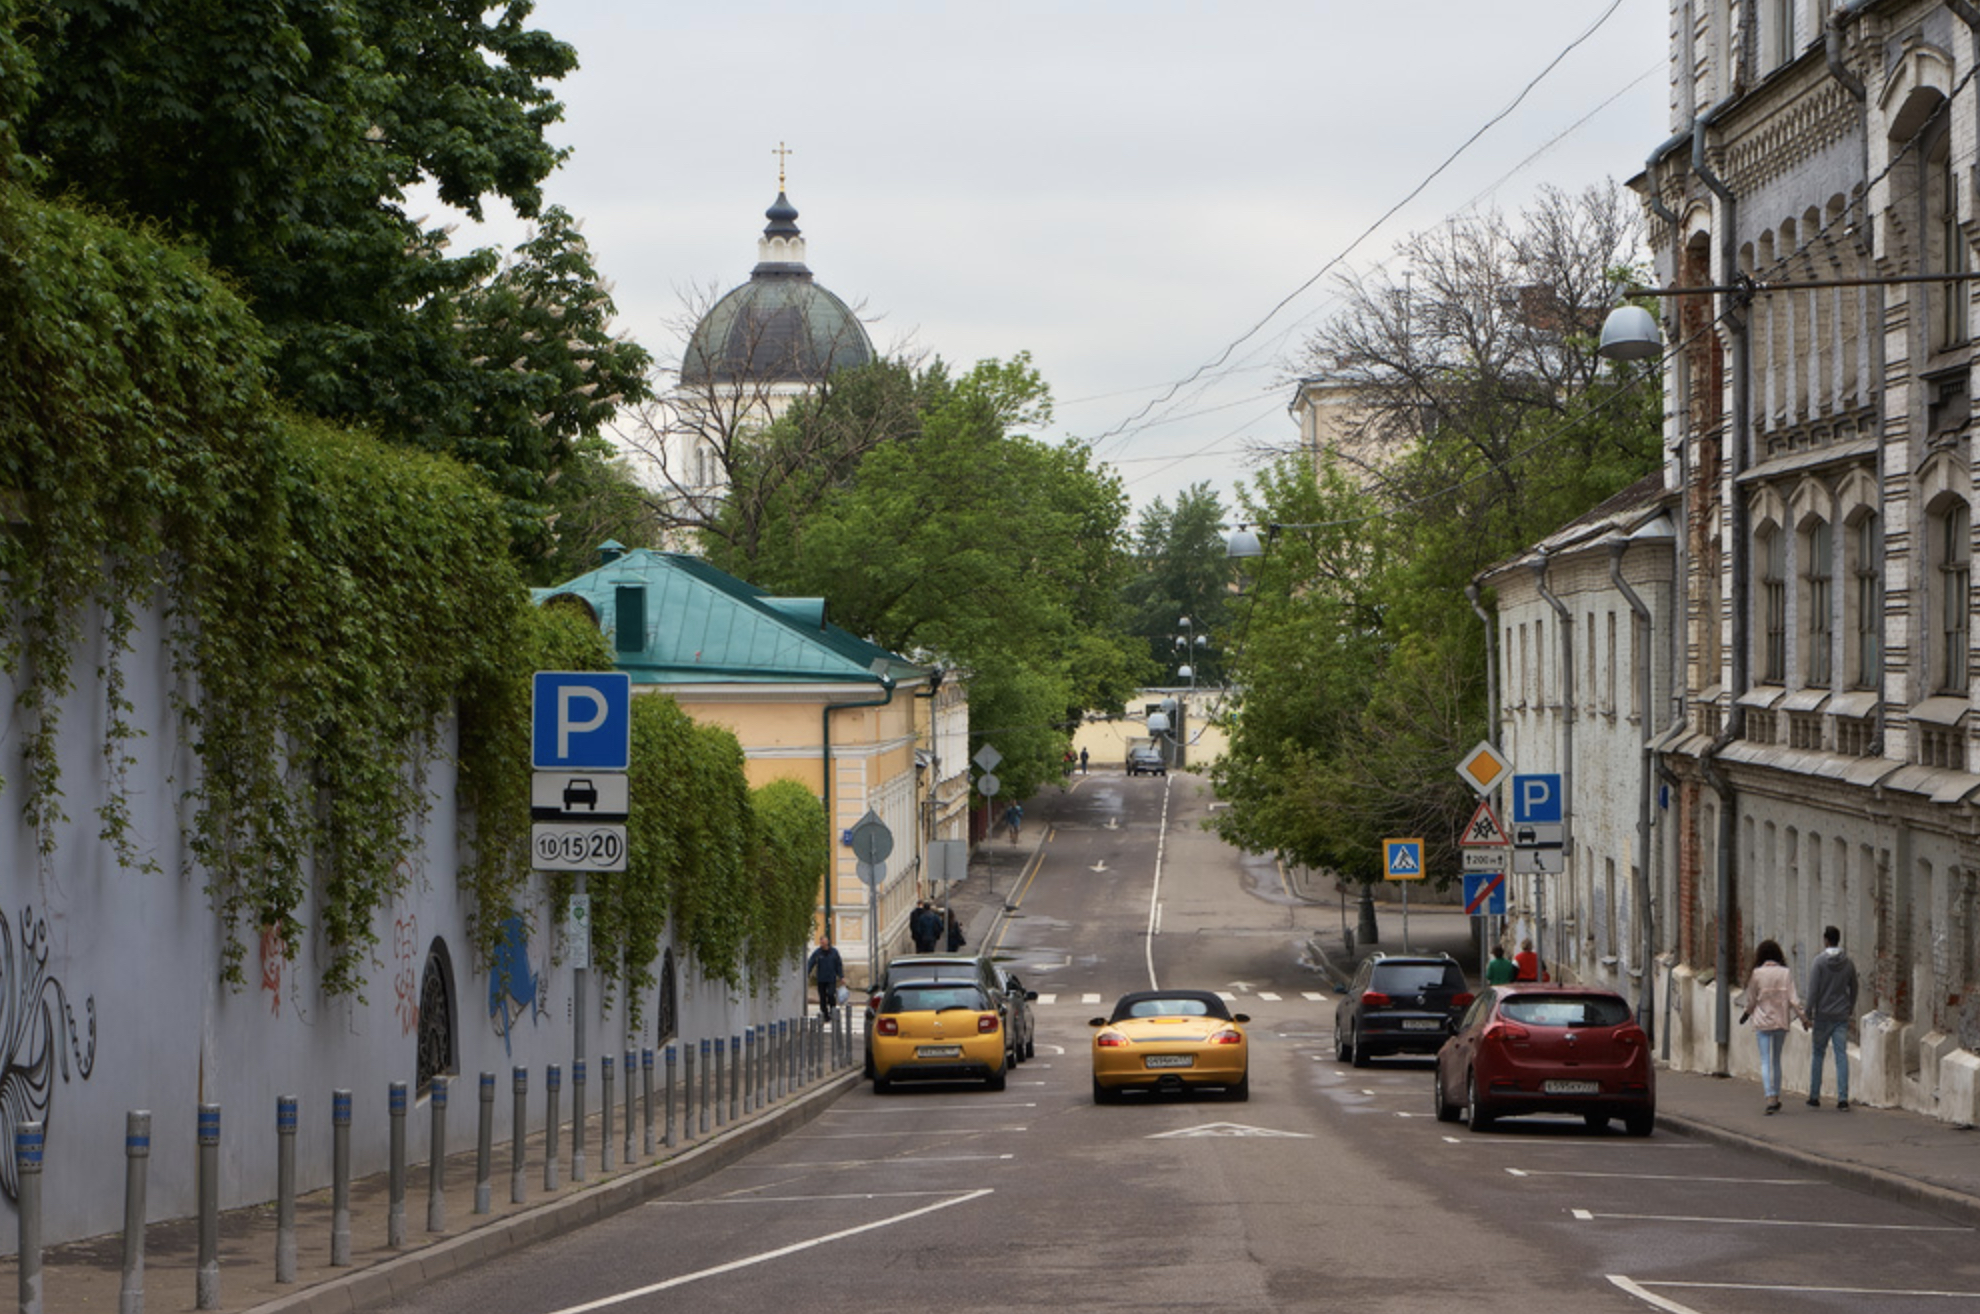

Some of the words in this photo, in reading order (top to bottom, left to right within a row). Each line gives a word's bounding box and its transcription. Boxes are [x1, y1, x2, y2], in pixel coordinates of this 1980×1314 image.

[558, 686, 608, 758] P
[1524, 780, 1550, 817] P
[540, 839, 557, 855] 10
[562, 837, 583, 857] 15
[591, 834, 618, 859] 20
